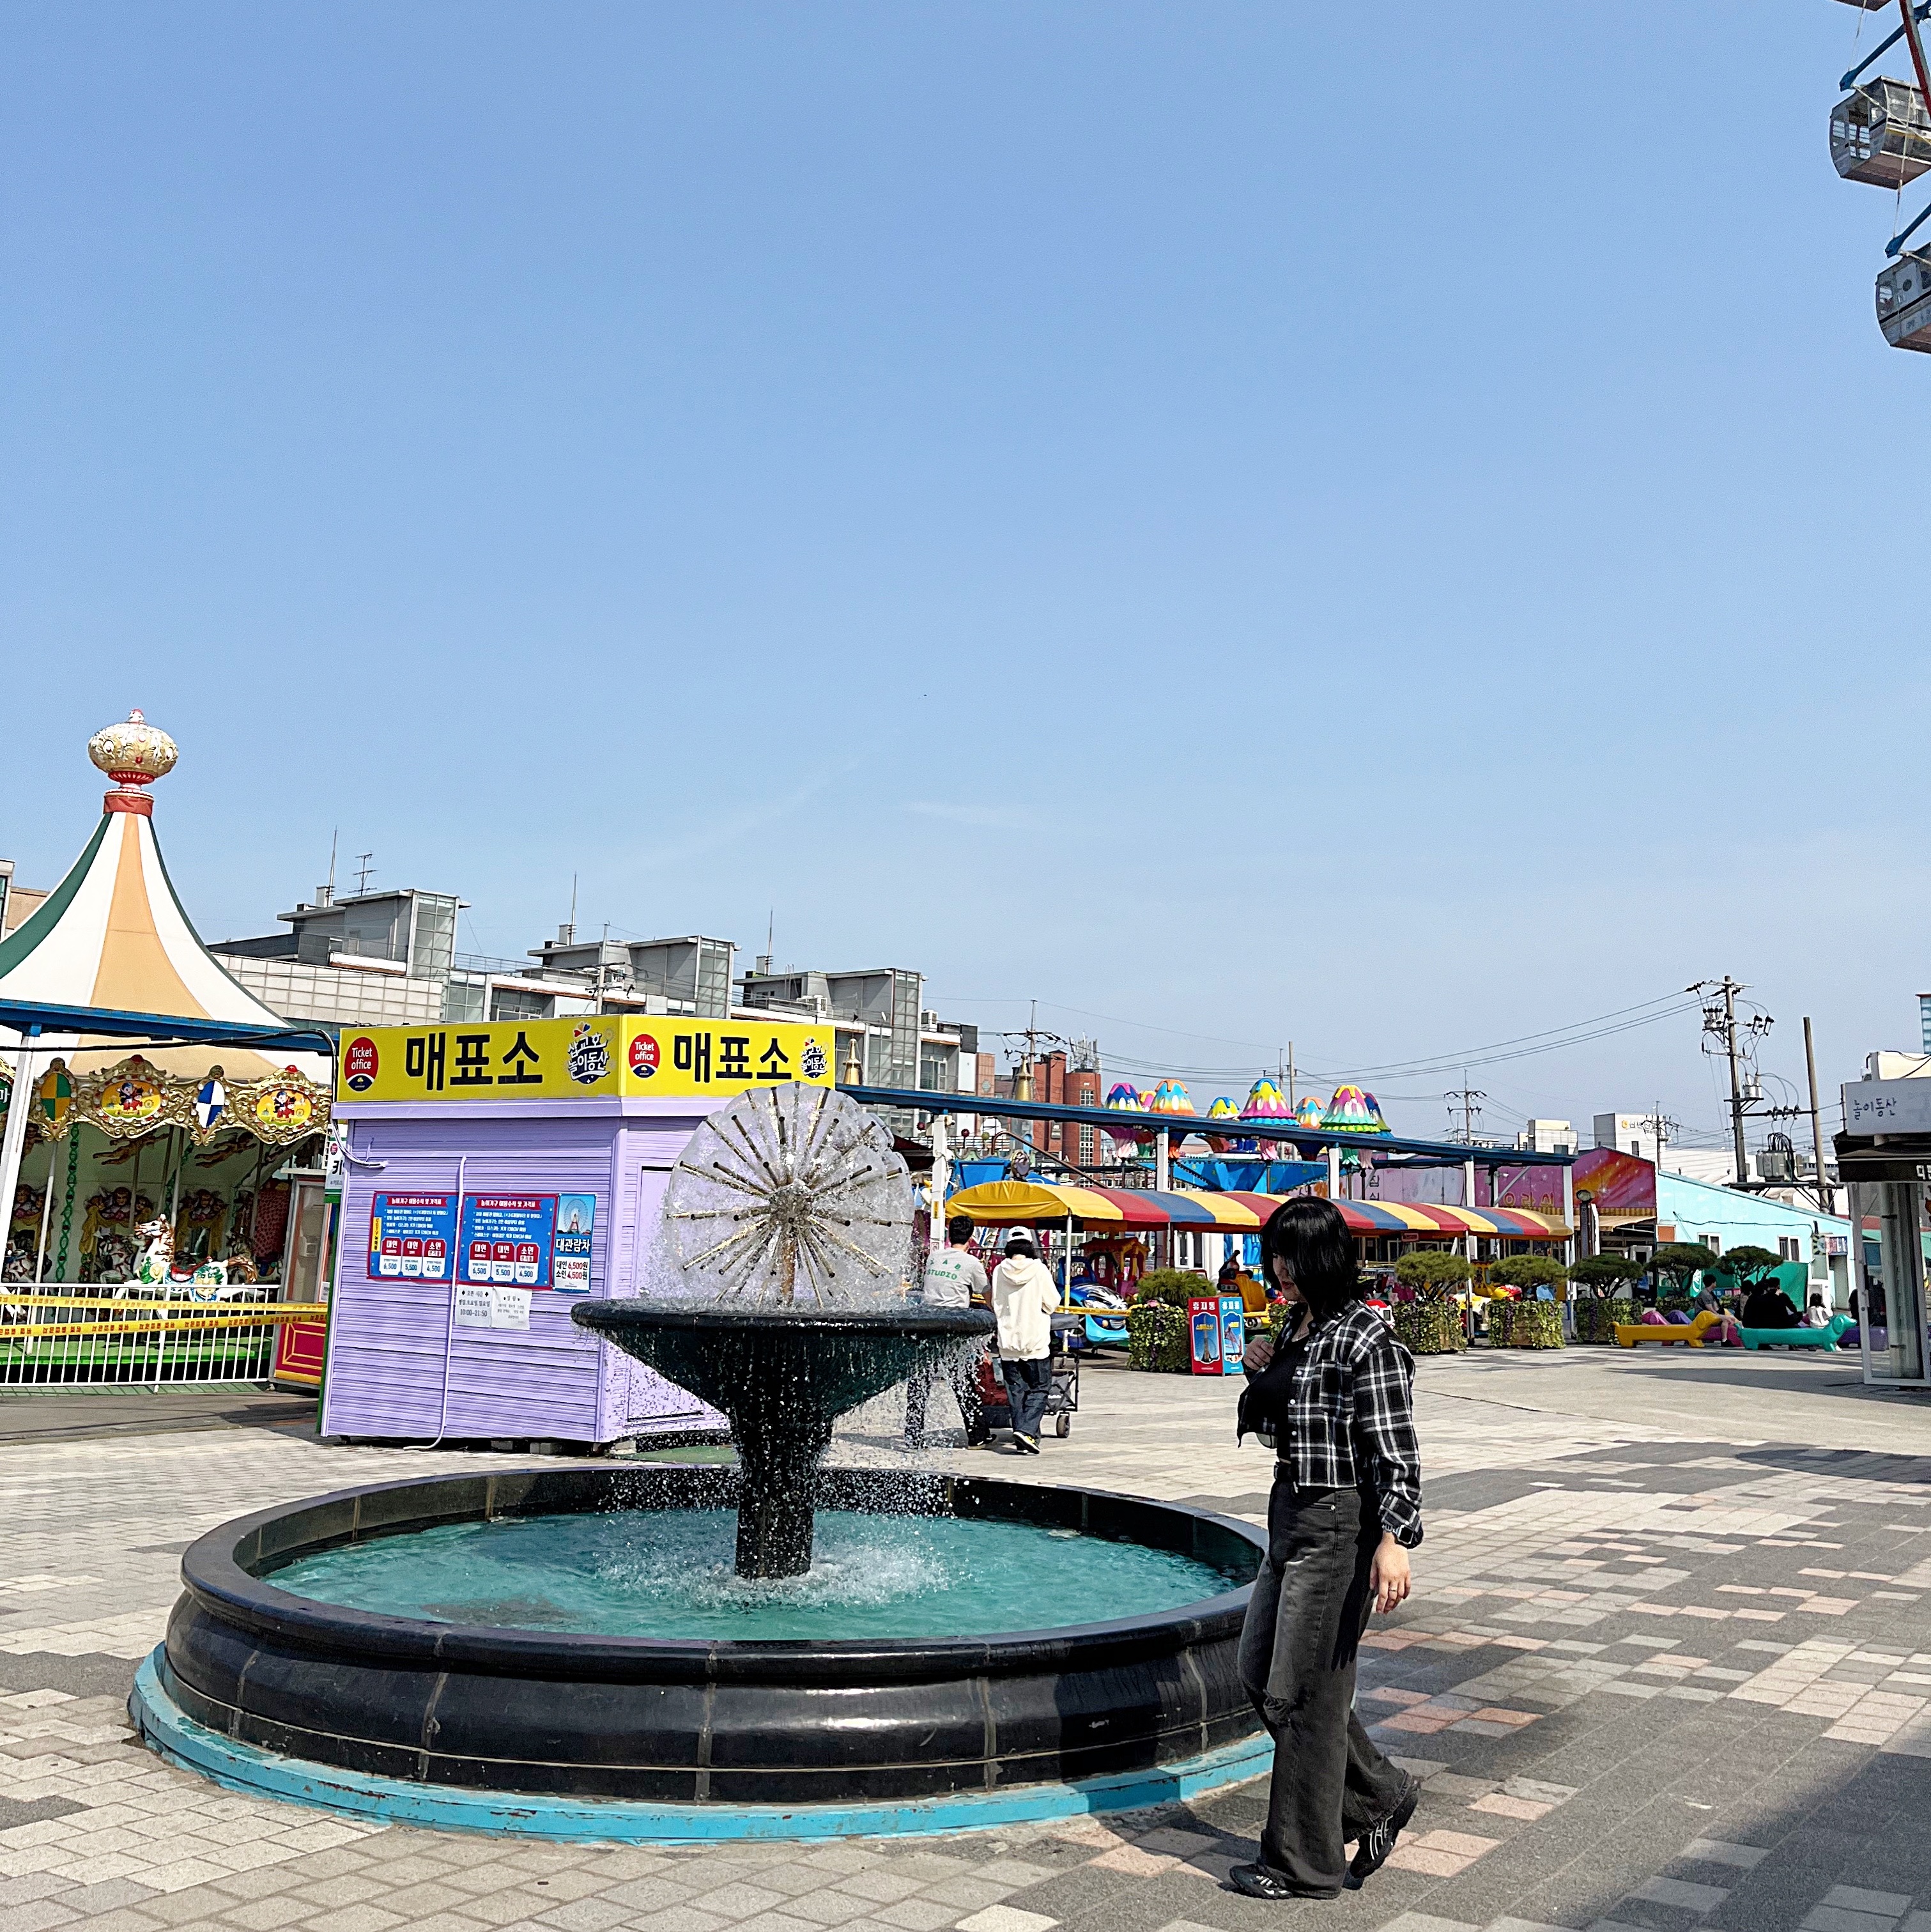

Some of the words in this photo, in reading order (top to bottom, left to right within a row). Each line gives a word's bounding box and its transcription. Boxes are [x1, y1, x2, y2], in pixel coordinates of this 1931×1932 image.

[568, 1032, 608, 1058] 삽교호
[635, 1042, 655, 1051] Ticket
[352, 1046, 373, 1058] Ticket
[635, 1051, 654, 1061] office
[674, 1033, 792, 1083] 매표소
[351, 1058, 372, 1070] office
[406, 1032, 542, 1090] 매표소
[568, 1051, 610, 1078] 놀이동산
[1853, 1097, 1897, 1120] 놀이동산
[555, 1238, 591, 1253] 대관람차
[556, 1261, 567, 1270] 대인
[568, 1262, 588, 1271] 6,500원
[556, 1270, 567, 1279] 소인
[567, 1271, 587, 1280] 4,500원
[927, 1269, 957, 1279] STUDIO
[1192, 1301, 1216, 1310] 휴지통
